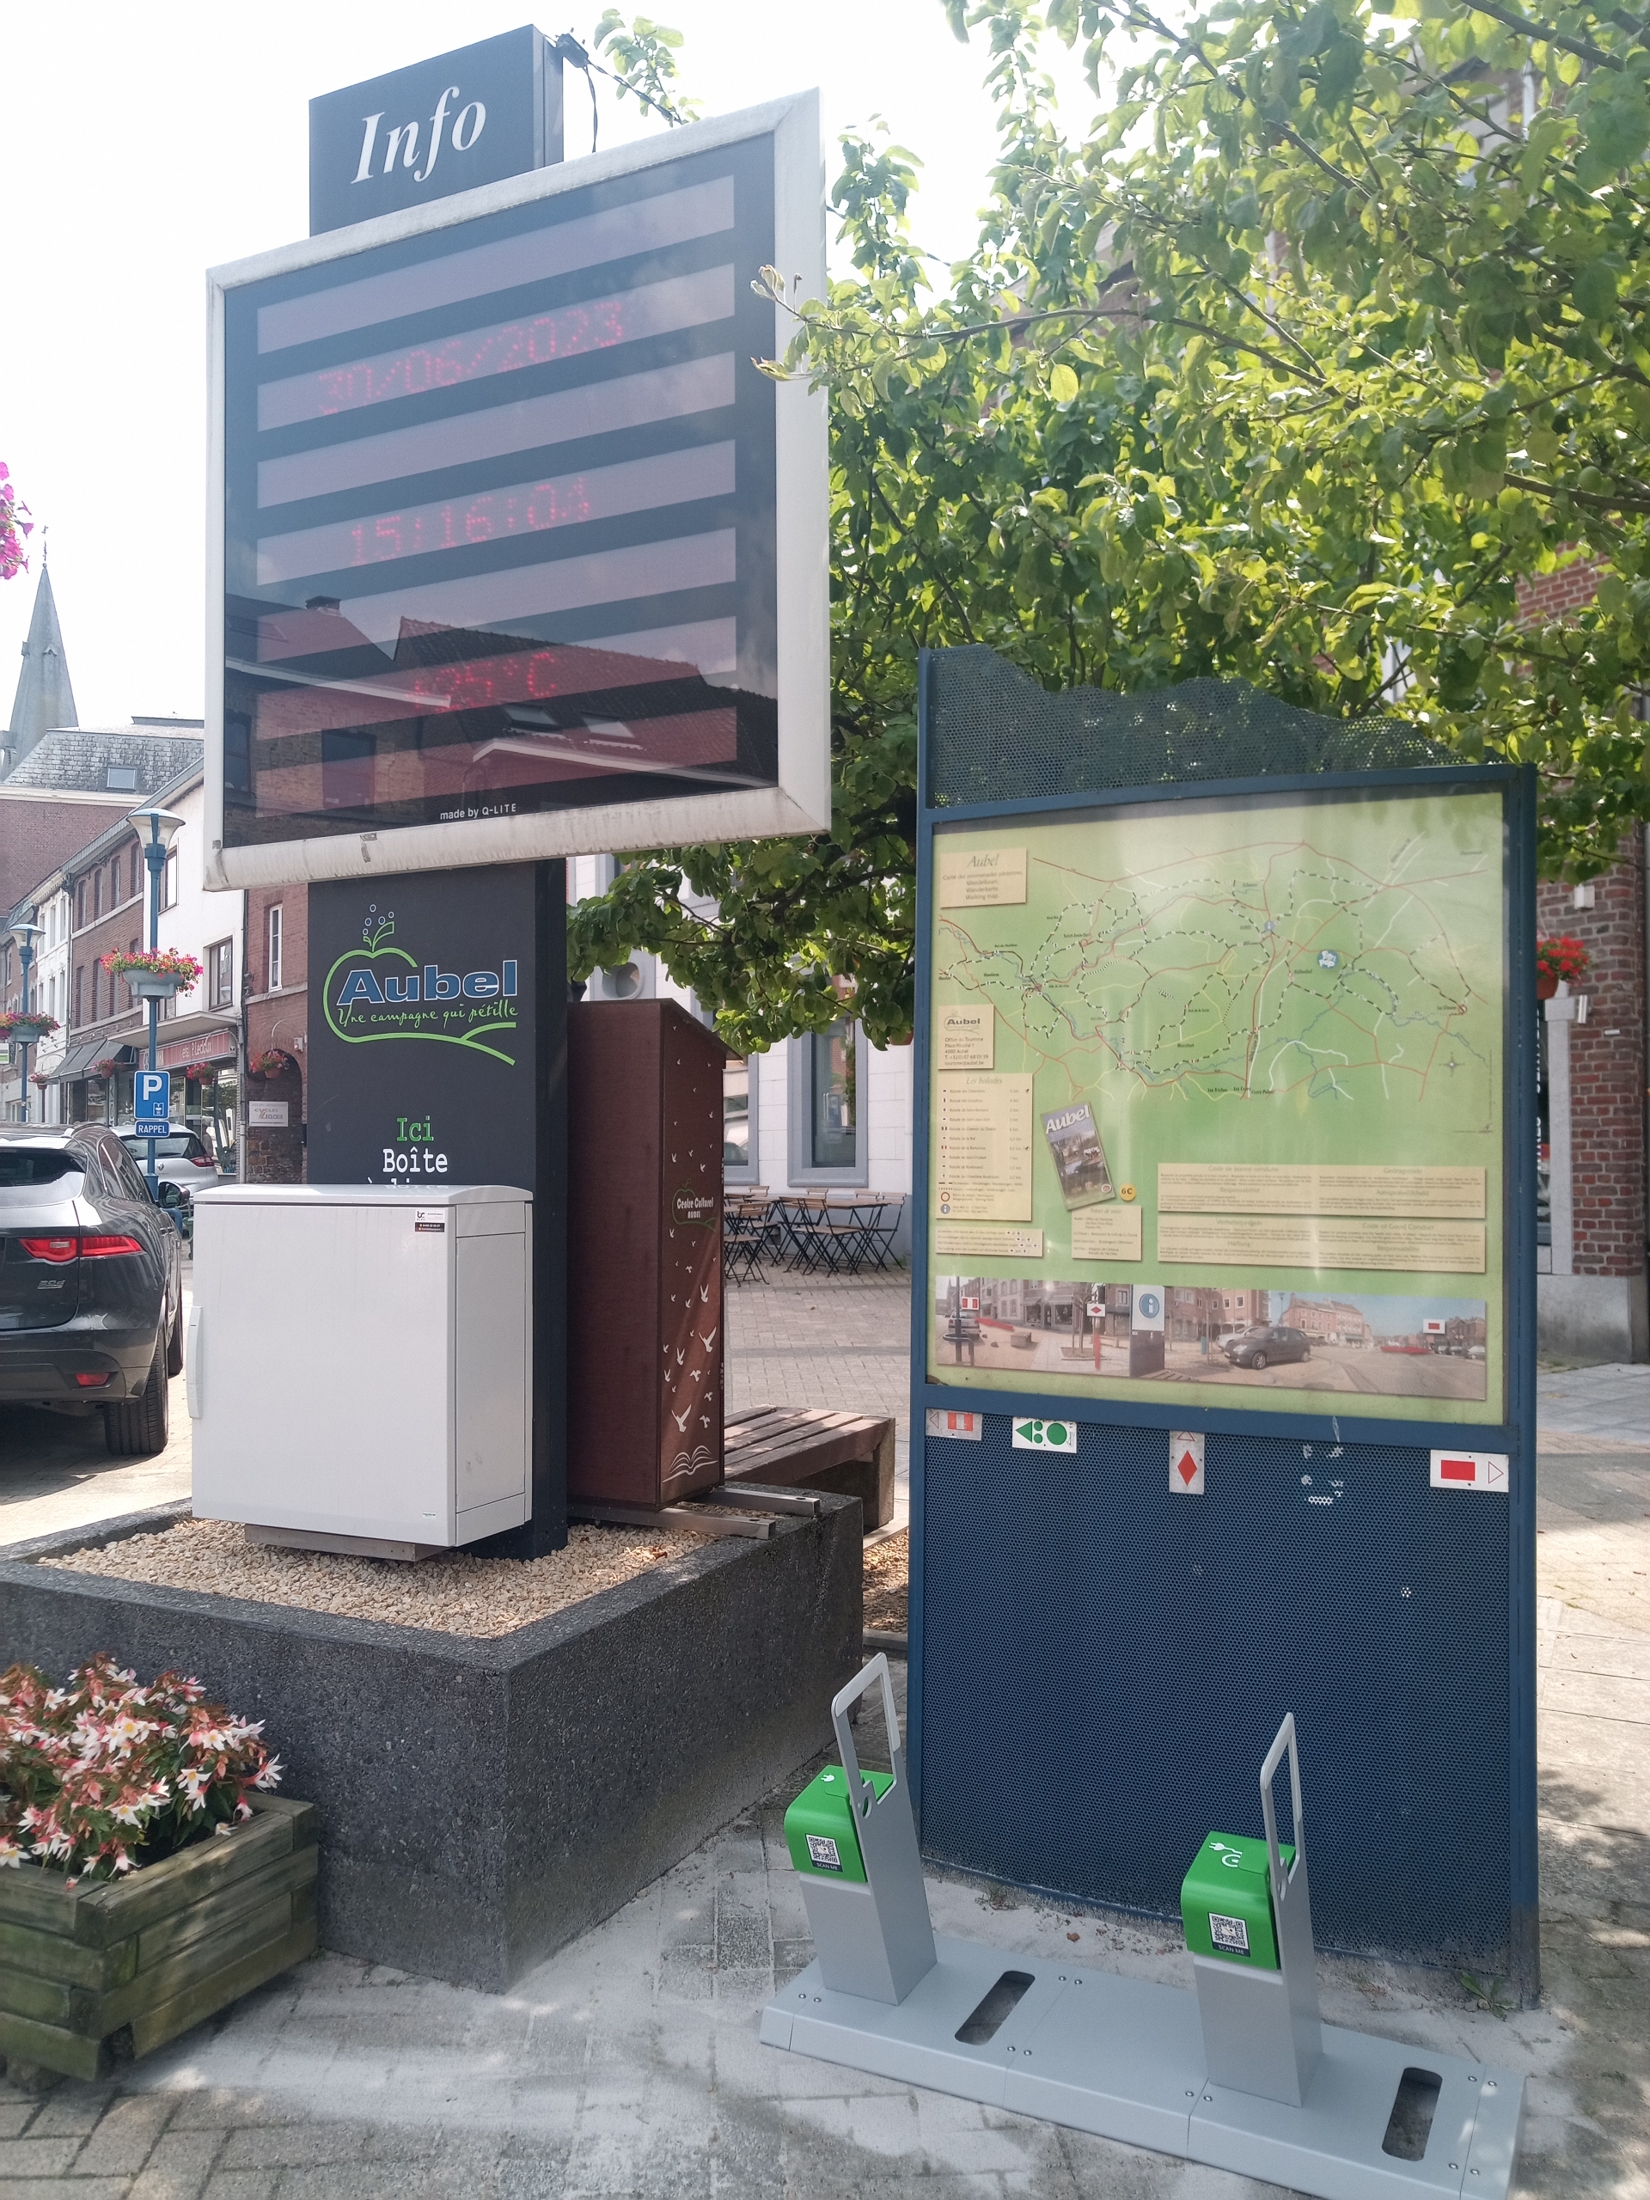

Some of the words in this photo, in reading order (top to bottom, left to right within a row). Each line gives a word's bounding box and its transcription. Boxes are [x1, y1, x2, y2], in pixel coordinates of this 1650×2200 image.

[349, 84, 487, 184] Info
[318, 301, 622, 415] 30/06/2023
[440, 809, 465, 820] made
[468, 808, 479, 819] by
[482, 803, 517, 815] Q-LITE
[967, 853, 1000, 868] Aubel
[337, 960, 517, 1006] Aubel
[338, 1003, 366, 1027] Une
[371, 1011, 438, 1028] campagne
[443, 1004, 465, 1029] qui
[468, 999, 518, 1022] pétille
[143, 1074, 163, 1101] P
[138, 1124, 167, 1134] RAPPEL
[397, 1115, 434, 1142] Ici
[1045, 1104, 1091, 1135] Aubel
[383, 1146, 448, 1173] Boîte
[676, 1198, 694, 1209] Centre
[694, 1197, 714, 1209] Culturel
[1218, 1945, 1234, 1953] SCAN
